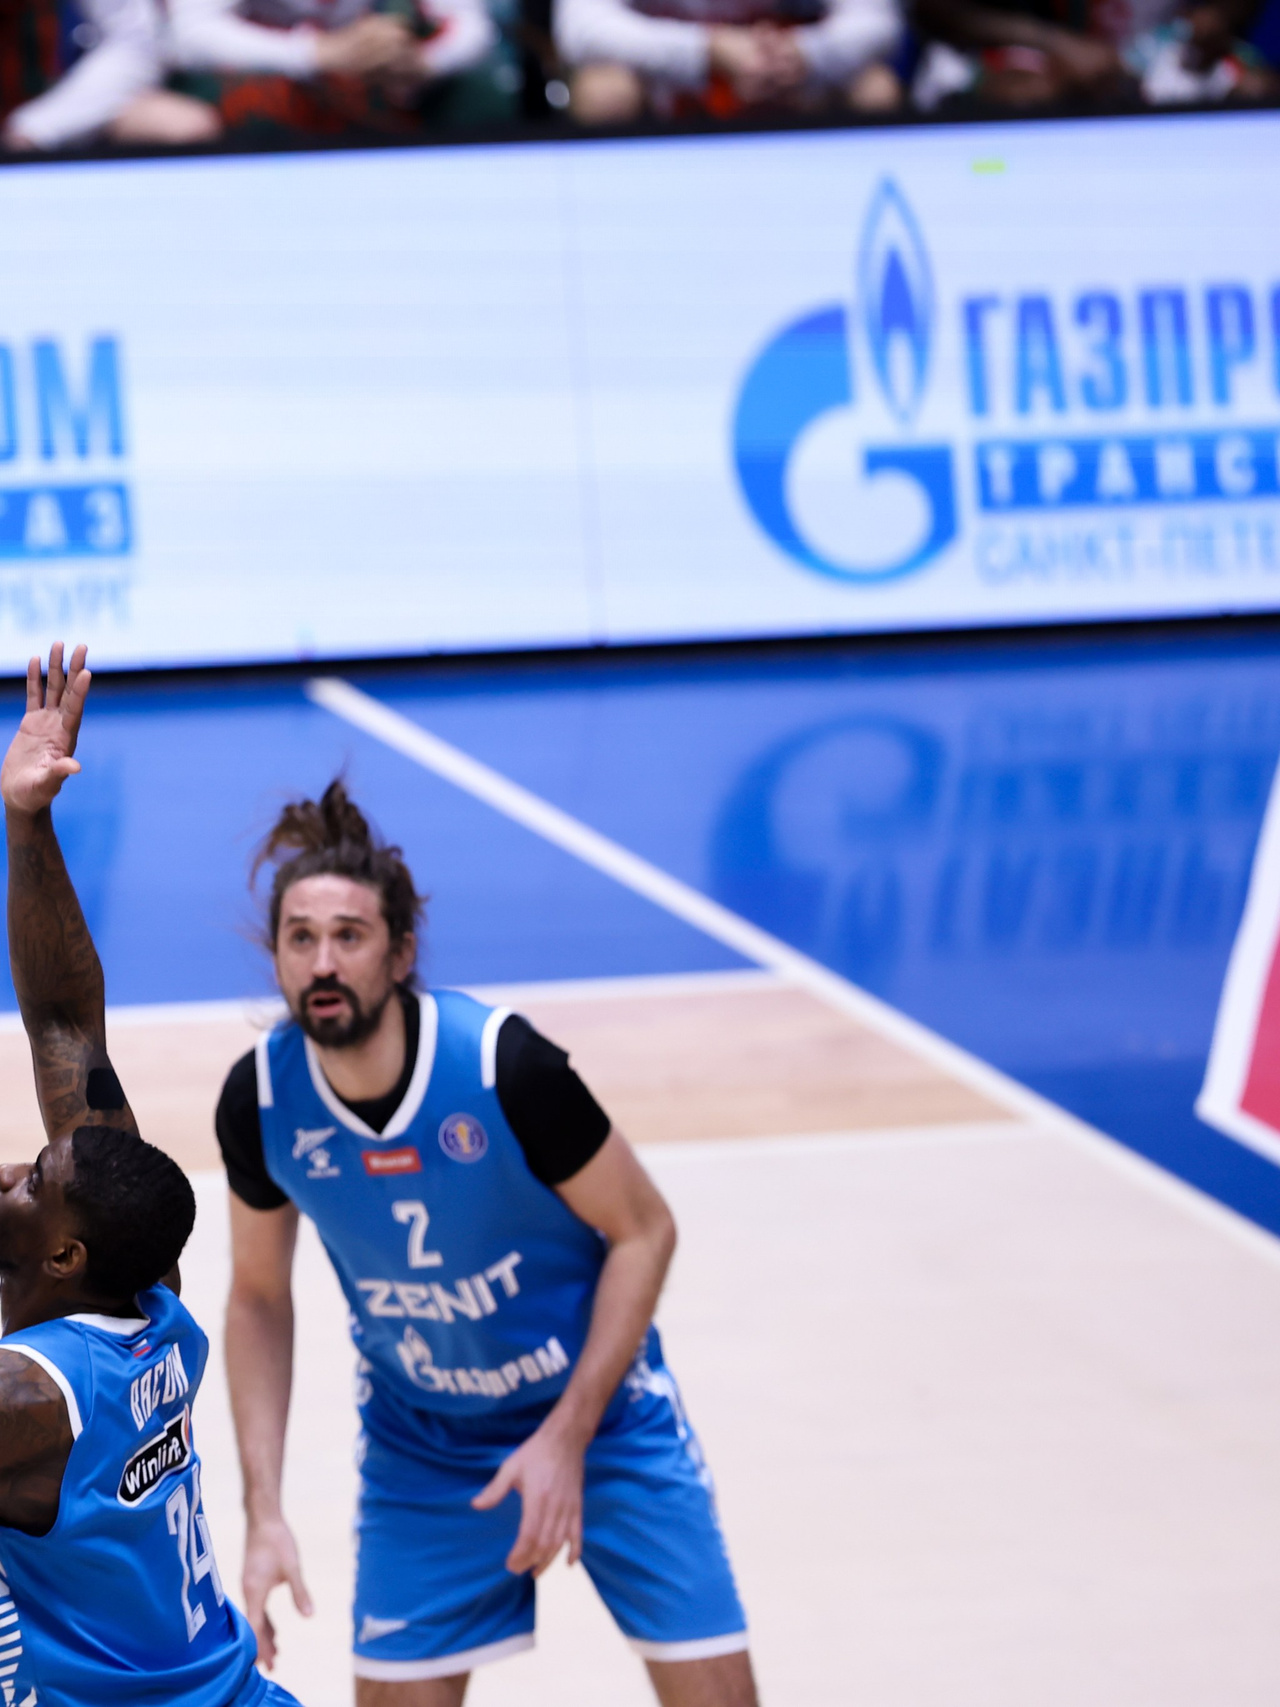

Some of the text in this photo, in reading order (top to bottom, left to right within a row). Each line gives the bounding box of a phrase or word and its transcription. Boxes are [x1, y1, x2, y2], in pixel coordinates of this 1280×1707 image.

[963, 284, 1280, 415] ГАЗПР
[980, 437, 1280, 506] ТРАНС
[392, 1200, 444, 1269] 2
[356, 1251, 522, 1324] ZENIT
[130, 1342, 189, 1432] BACON
[166, 1462, 225, 1643] 24
